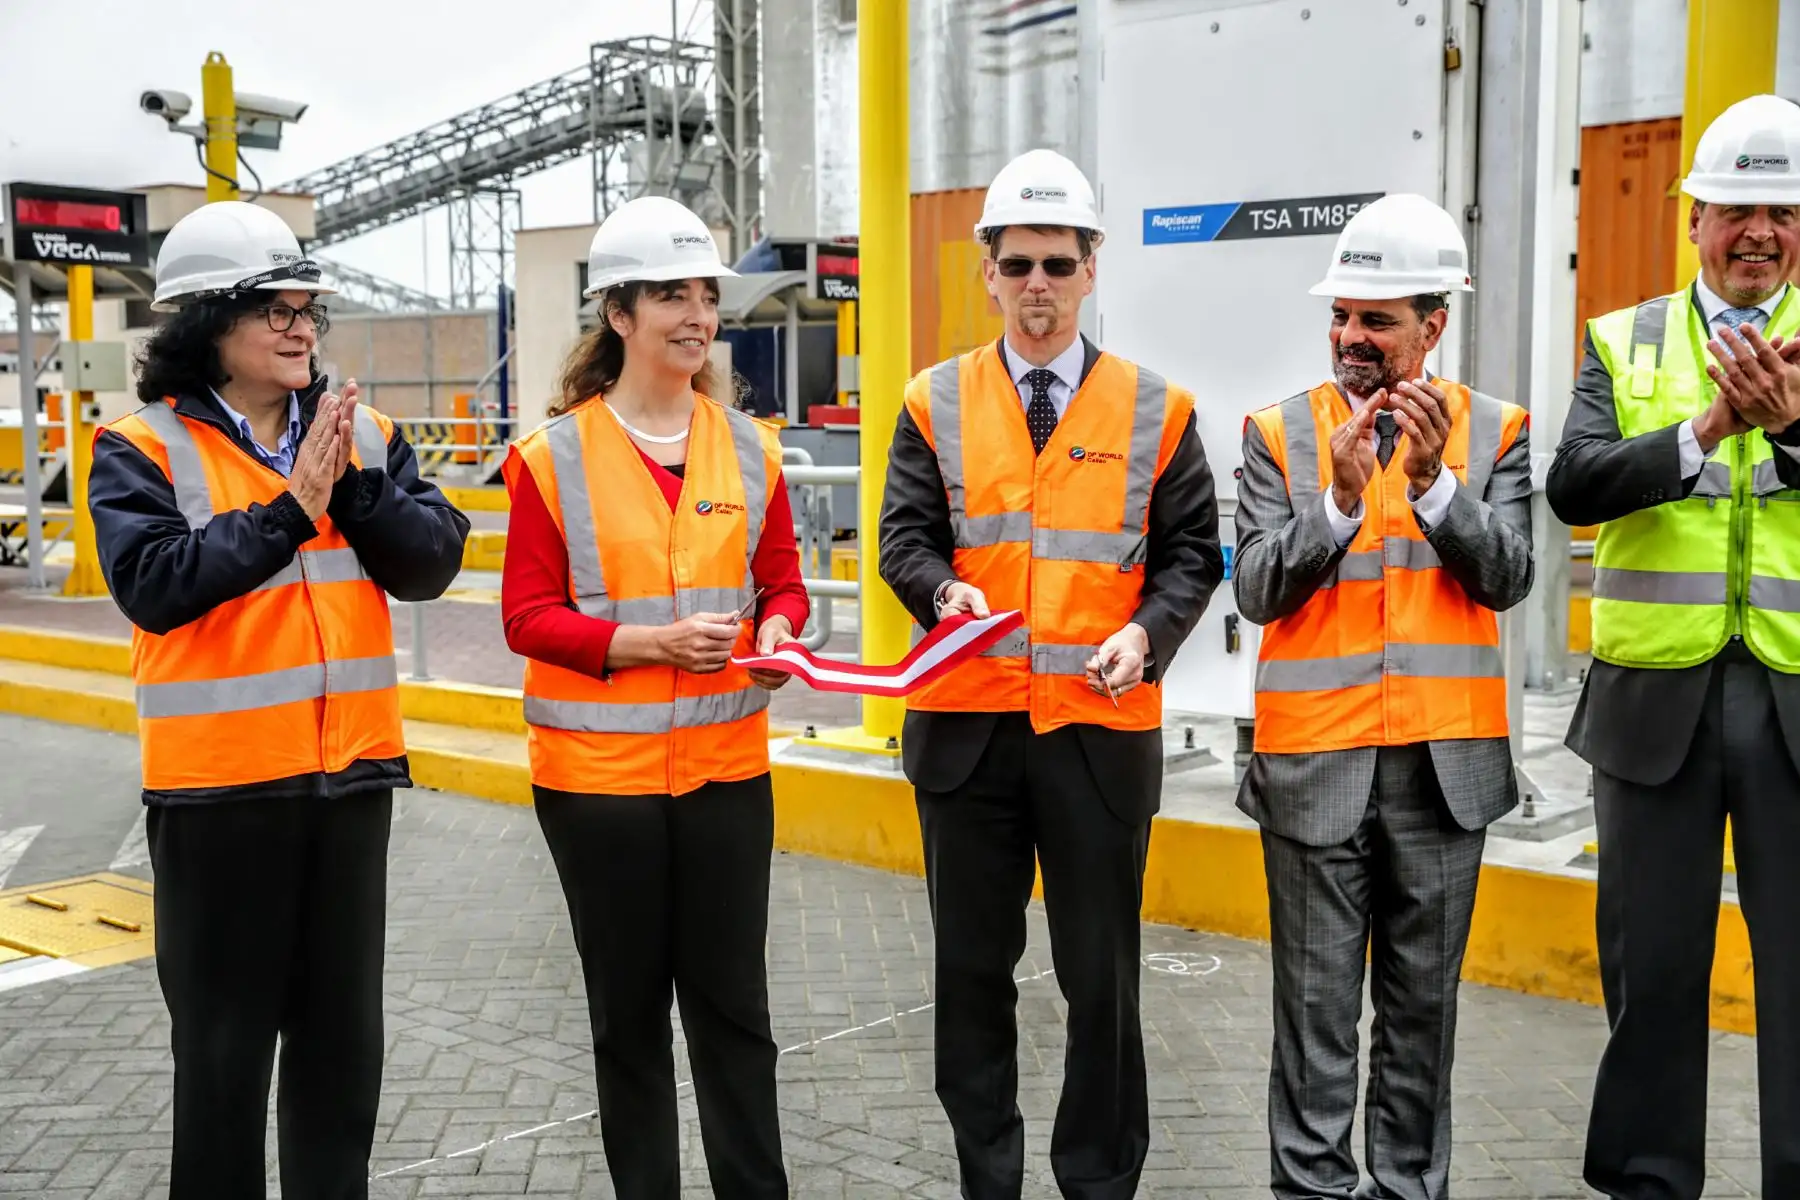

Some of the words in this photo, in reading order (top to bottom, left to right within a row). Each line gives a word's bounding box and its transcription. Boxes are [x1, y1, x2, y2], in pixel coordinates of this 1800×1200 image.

[1151, 212, 1202, 229] Rapiscan
[1249, 208, 1293, 231] TSA
[1298, 202, 1370, 228] TM85
[1098, 451, 1124, 460] WORLD
[724, 503, 745, 511] WORLD
